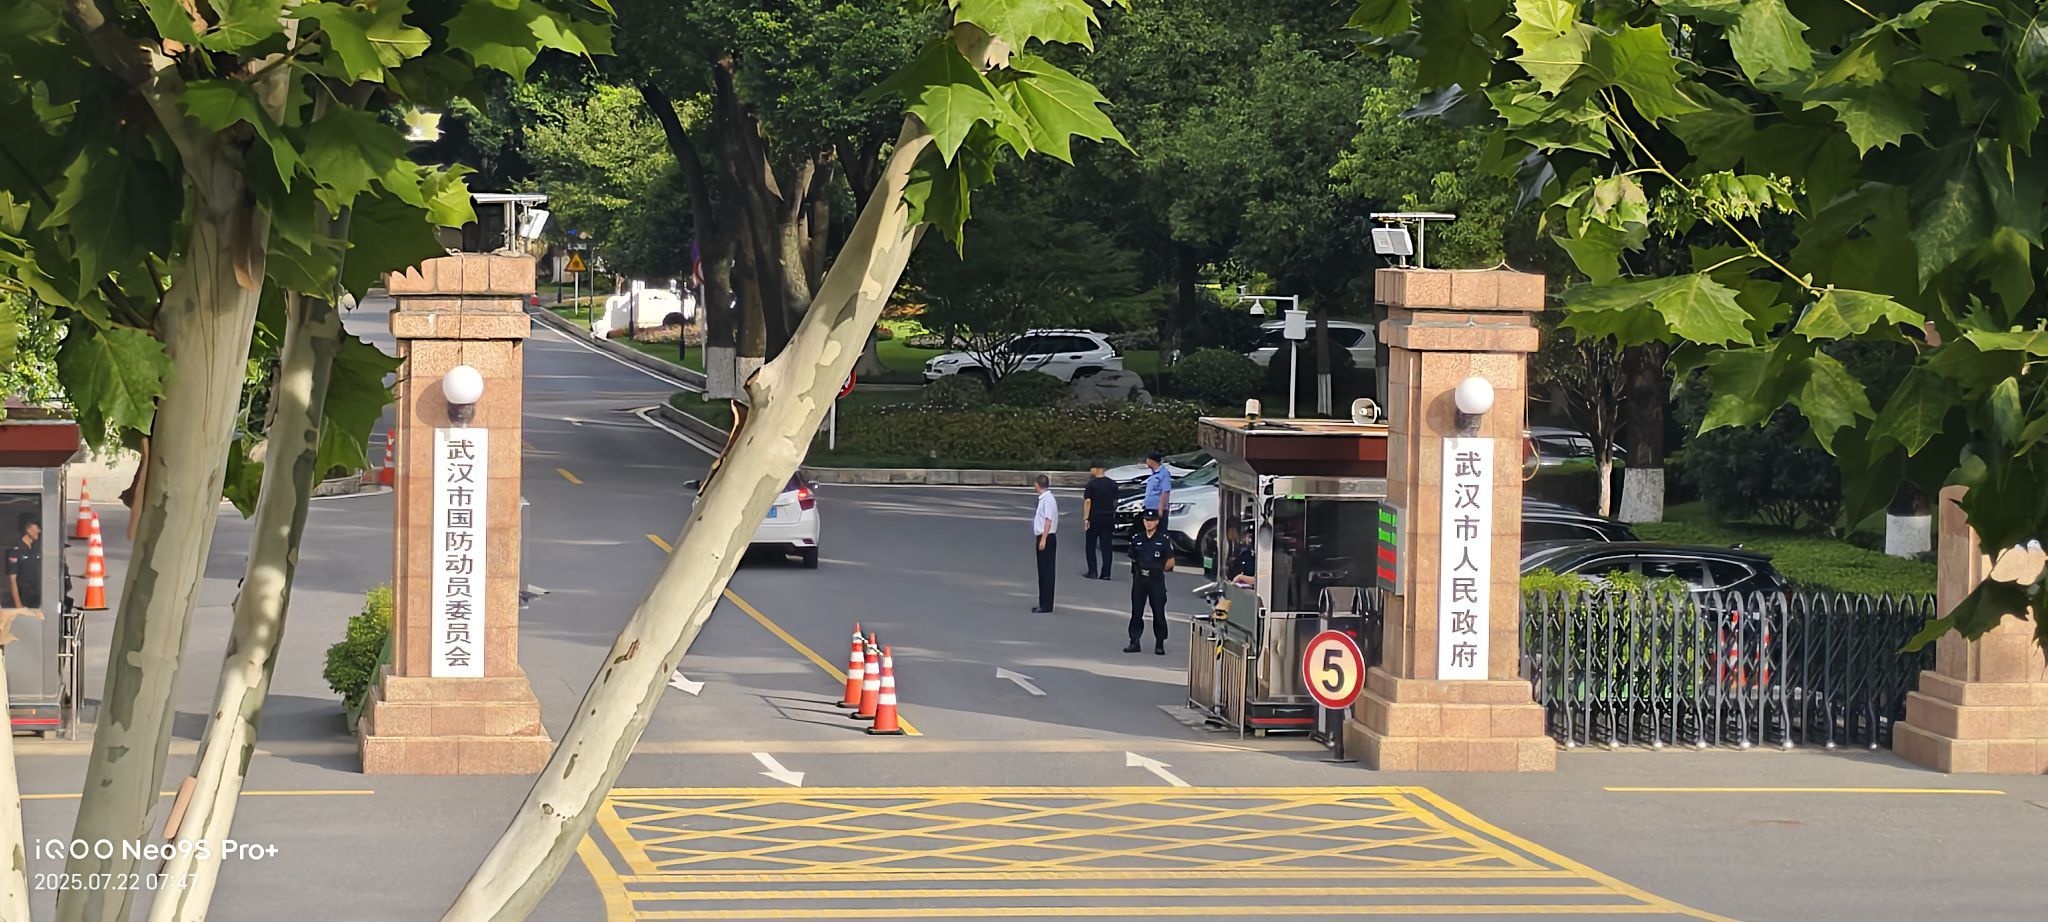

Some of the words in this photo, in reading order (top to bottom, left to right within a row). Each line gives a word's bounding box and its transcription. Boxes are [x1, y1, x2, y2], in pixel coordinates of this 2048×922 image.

[444, 439, 475, 668] 武汉市国防动员委员会
[1450, 451, 1483, 669] 武汉市人民政府
[1321, 648, 1346, 693] 5
